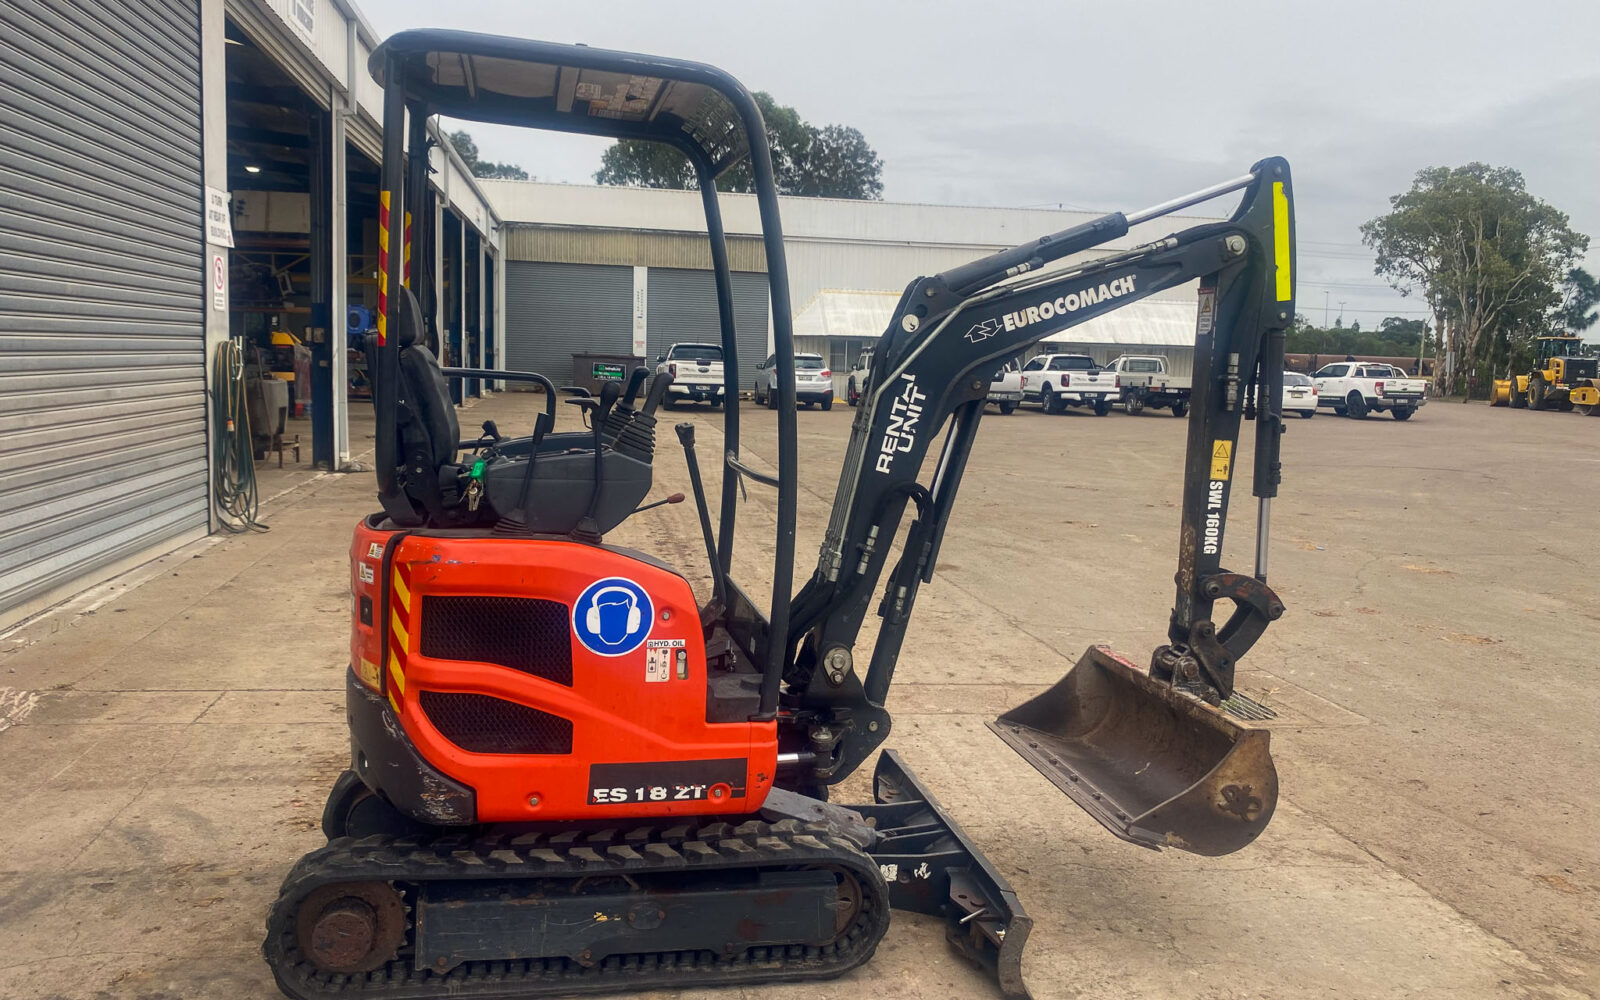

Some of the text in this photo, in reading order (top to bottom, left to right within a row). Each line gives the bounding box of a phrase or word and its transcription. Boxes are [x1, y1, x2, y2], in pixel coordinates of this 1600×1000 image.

[1003, 275, 1136, 332] EUROCOMACH
[897, 386, 926, 453] UNIT
[1203, 481, 1223, 555] SWL 160KG
[593, 788, 628, 803] ES
[635, 787, 667, 801] 18
